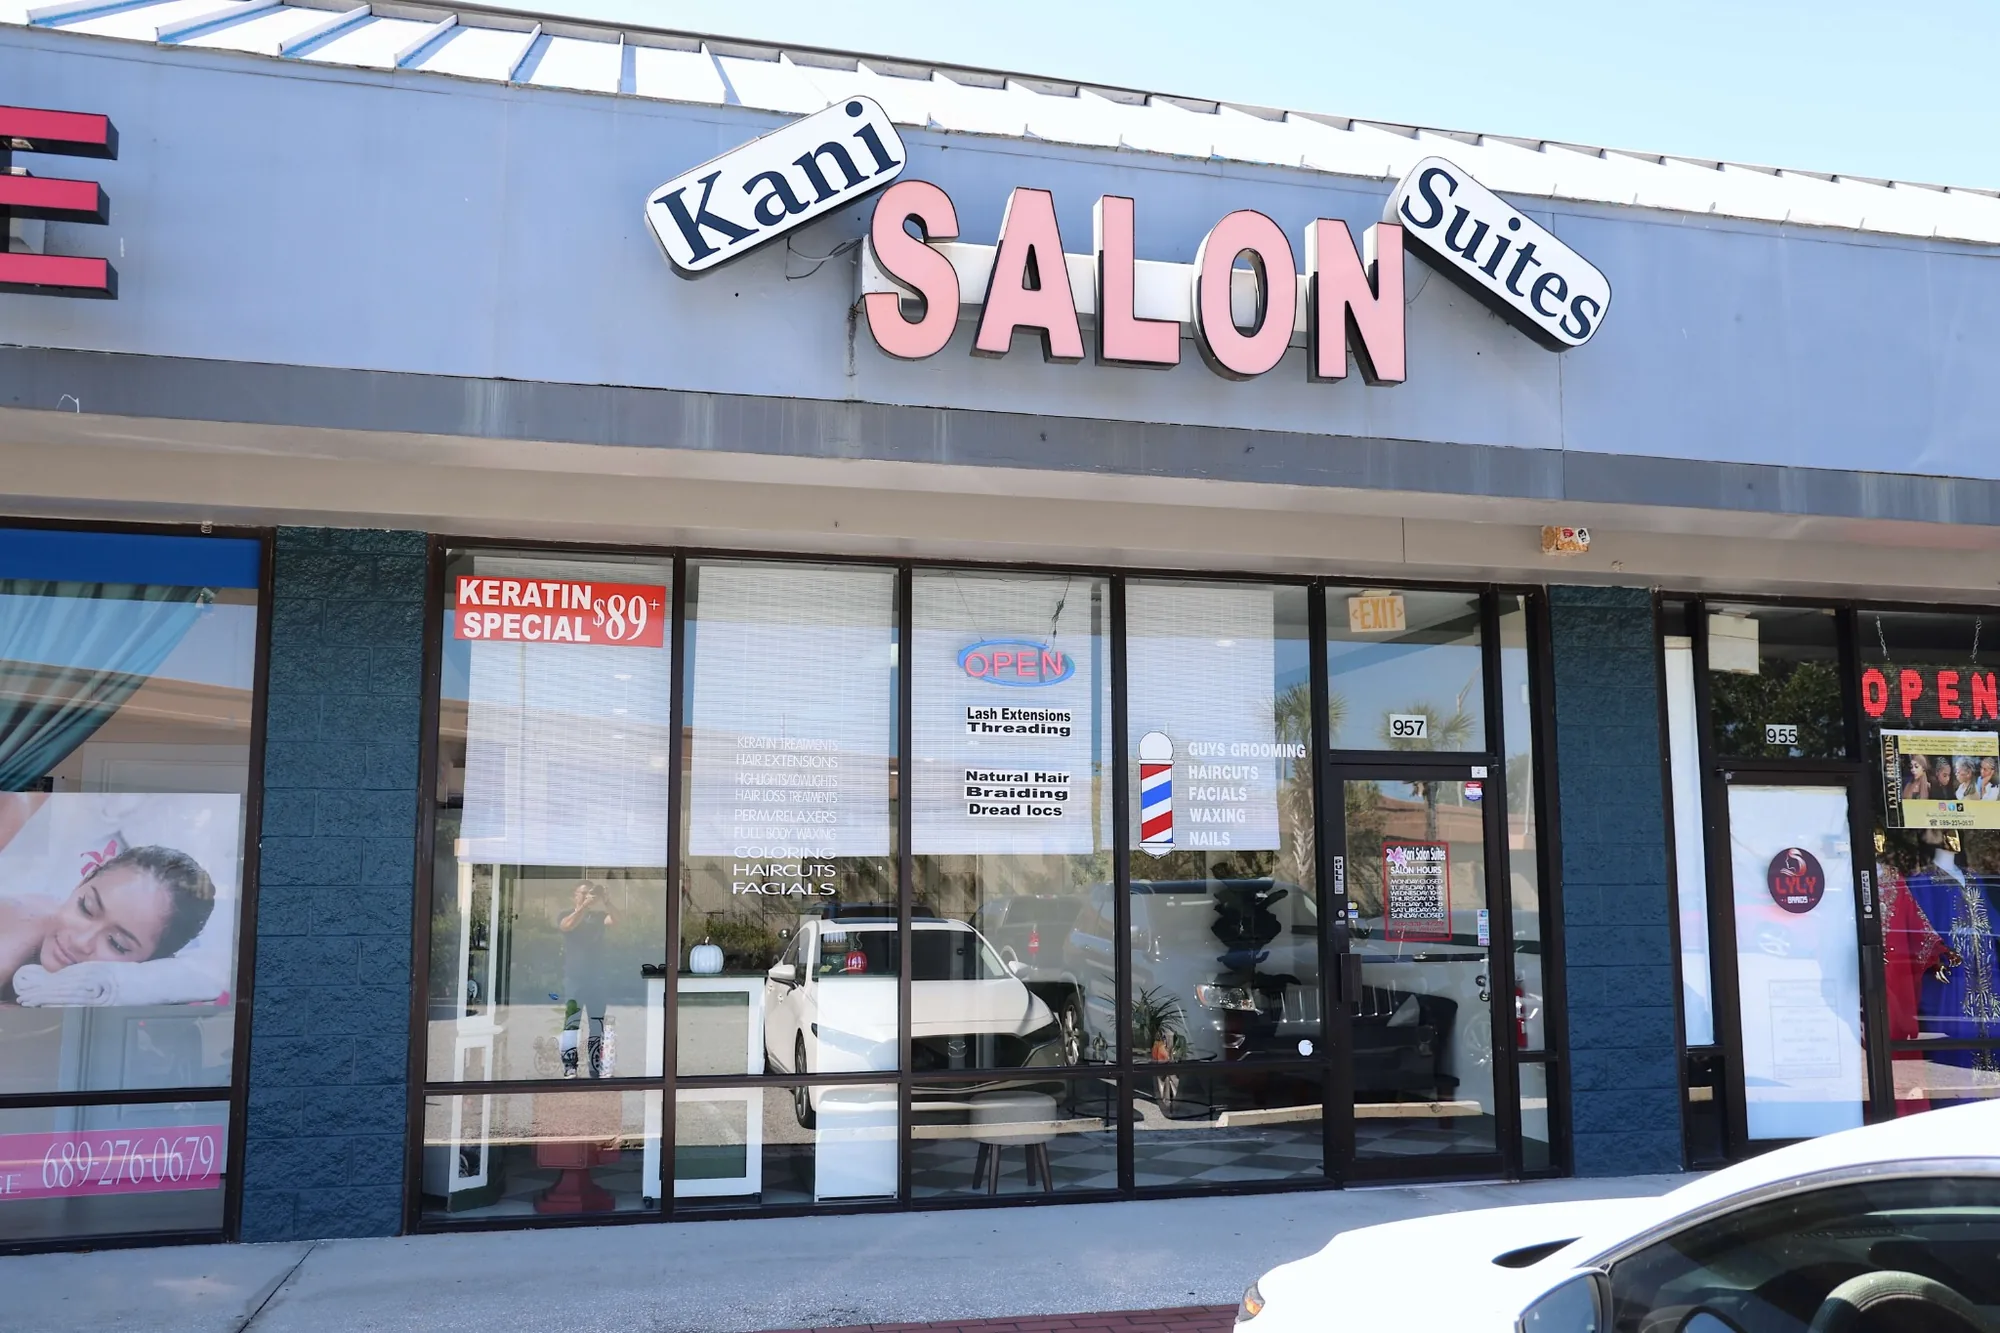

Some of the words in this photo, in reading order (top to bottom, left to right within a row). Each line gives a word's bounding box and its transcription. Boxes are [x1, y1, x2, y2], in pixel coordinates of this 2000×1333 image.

[654, 101, 901, 265] Kani
[1400, 167, 1601, 341] Suites
[863, 179, 1407, 385] SALON
[459, 578, 592, 610] KERATIN
[1359, 598, 1396, 629] EXIT
[463, 612, 591, 642] SPECIAL
[965, 651, 1063, 677] OPEN
[1861, 668, 1998, 720] OPEN
[967, 707, 997, 720] Lash
[1001, 708, 1071, 722] Extensions
[967, 722, 1071, 737] Threading
[1393, 719, 1425, 736] 957
[1767, 728, 1798, 743] 955
[737, 736, 776, 749] KERATIN
[780, 738, 838, 751] TREATMENTS
[1188, 742, 1226, 757] GUYS
[1230, 743, 1307, 758] GROOMING
[736, 754, 762, 765] HAIR
[765, 754, 838, 768] EXTENSIONS
[1885, 735, 1895, 780] BRAIDS
[965, 771, 1029, 782] Natural
[1035, 772, 1070, 783] Hair
[1188, 765, 1259, 780] HAIRCUTS
[735, 790, 760, 801] HAIR
[763, 790, 786, 802] LOSS
[789, 791, 838, 803] TREATMENTS
[966, 786, 1068, 801] Braiding
[1188, 786, 1247, 801] FACIALS
[734, 808, 837, 824] PERM/RELAXERS
[969, 803, 1021, 816] Dread
[1027, 804, 1063, 817] locs
[1189, 808, 1246, 823] WAXING
[734, 827, 761, 839] FULL
[766, 828, 792, 840] BODY
[796, 828, 837, 841] WAXING
[1189, 831, 1230, 846] NAILS
[733, 846, 836, 860] COLORING
[1416, 846, 1430, 860] Salon
[1431, 846, 1446, 860] Suites
[733, 864, 836, 877] HAIRCUTS
[732, 882, 836, 896] FACIALS
[1775, 877, 1816, 894] LYLY
[42, 1135, 215, 1189] 689-276-0679
